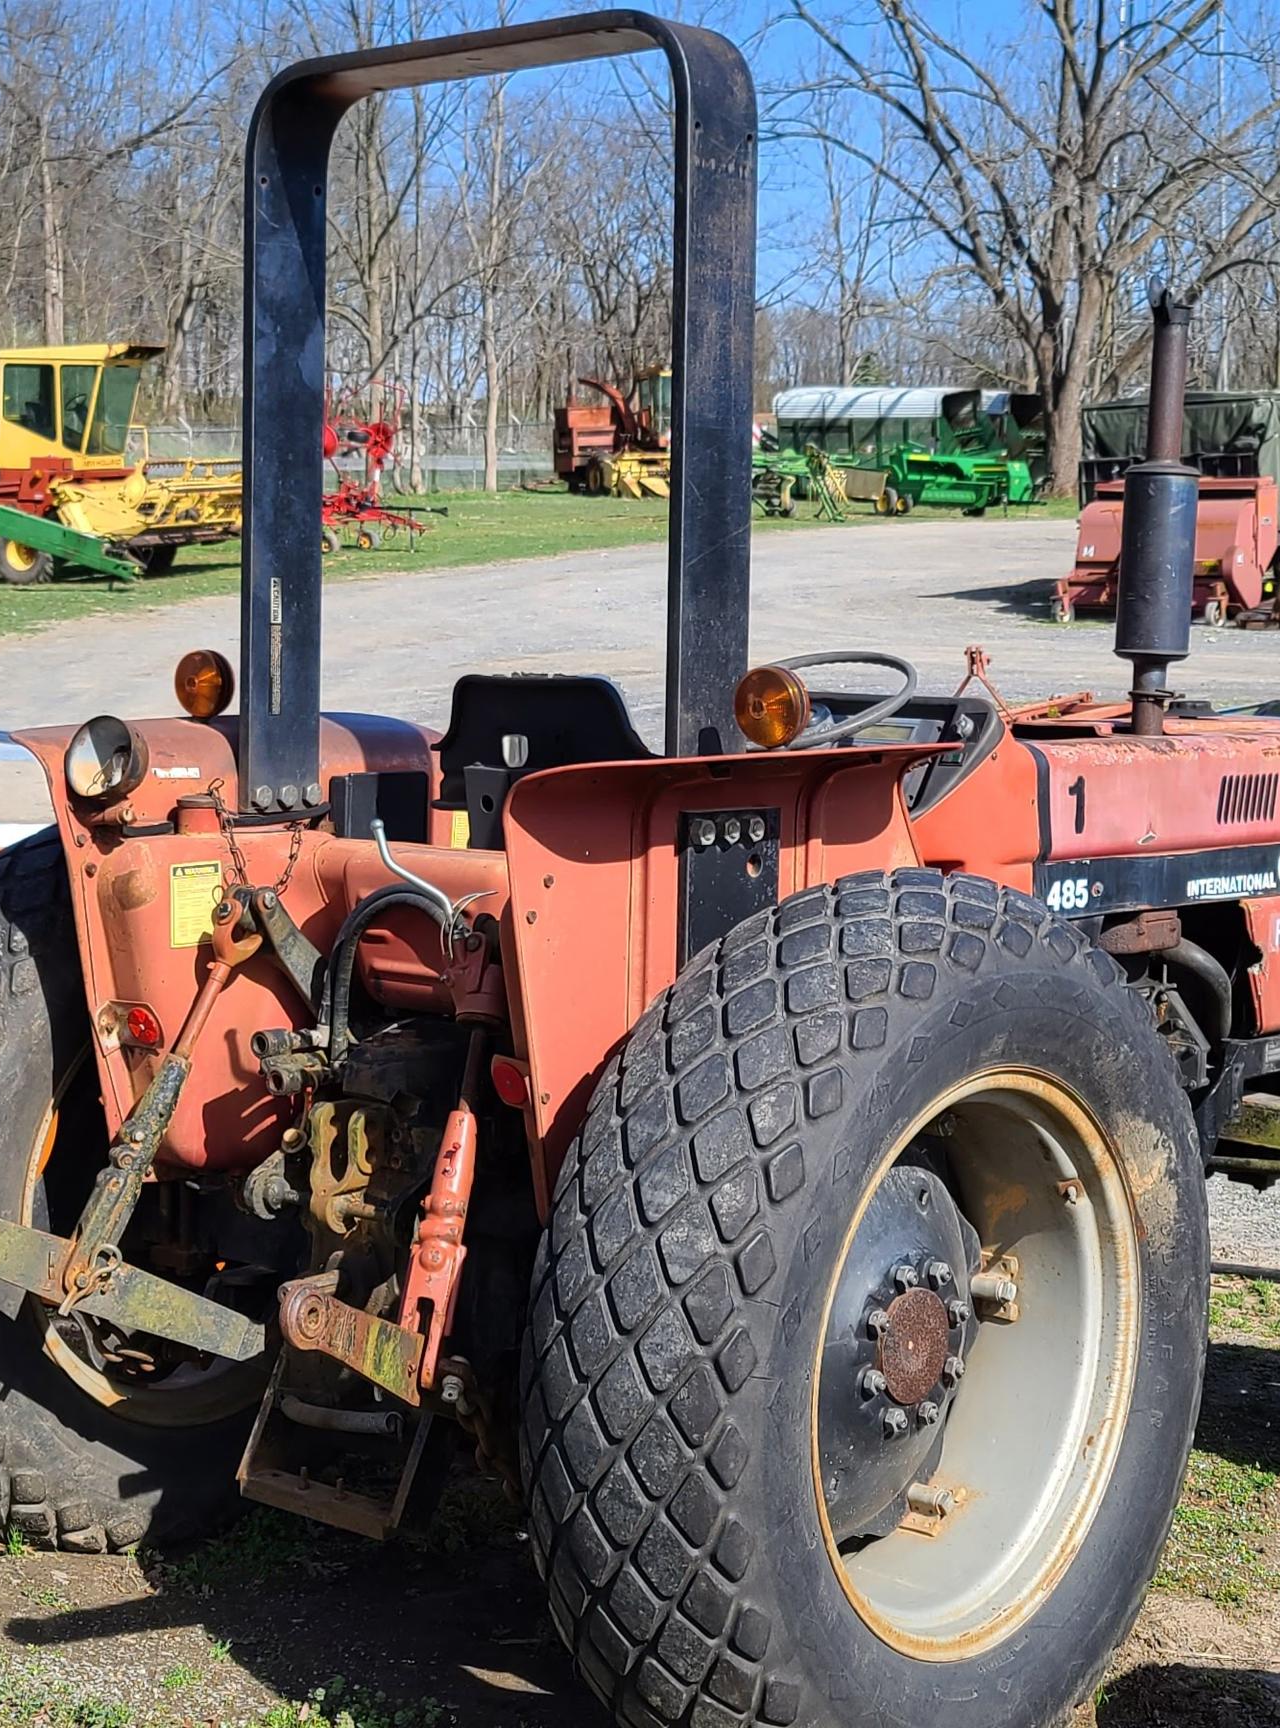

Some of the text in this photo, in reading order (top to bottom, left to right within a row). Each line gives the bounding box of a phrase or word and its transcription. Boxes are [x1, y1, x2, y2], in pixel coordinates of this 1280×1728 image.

[272, 590, 280, 622] CAUTION
[1068, 775, 1086, 834] 1
[1046, 878, 1089, 911] 485
[1187, 872, 1277, 897] INTERNATIONAL
